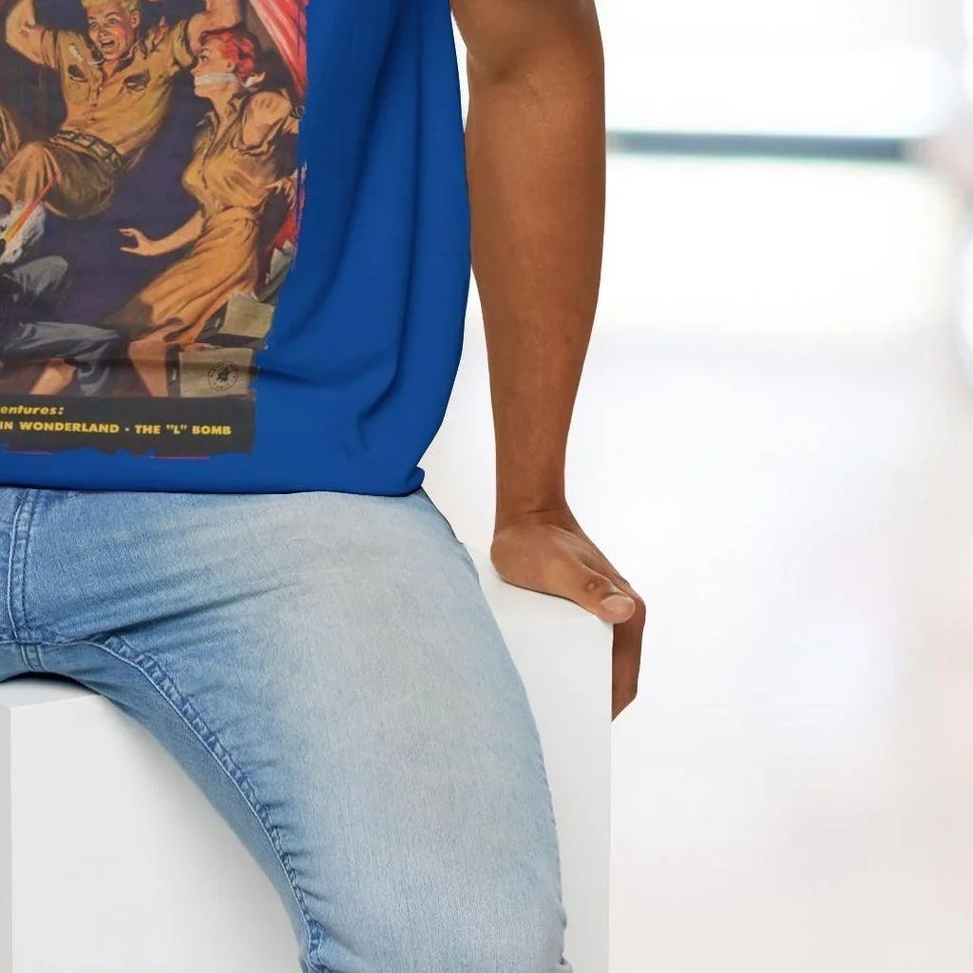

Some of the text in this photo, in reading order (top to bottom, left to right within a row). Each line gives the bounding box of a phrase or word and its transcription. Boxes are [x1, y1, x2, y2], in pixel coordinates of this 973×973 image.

[0, 421, 13, 430] IN
[19, 421, 120, 434] WONDERLAND
[134, 424, 161, 434] THE
[192, 425, 232, 435] BOMB
